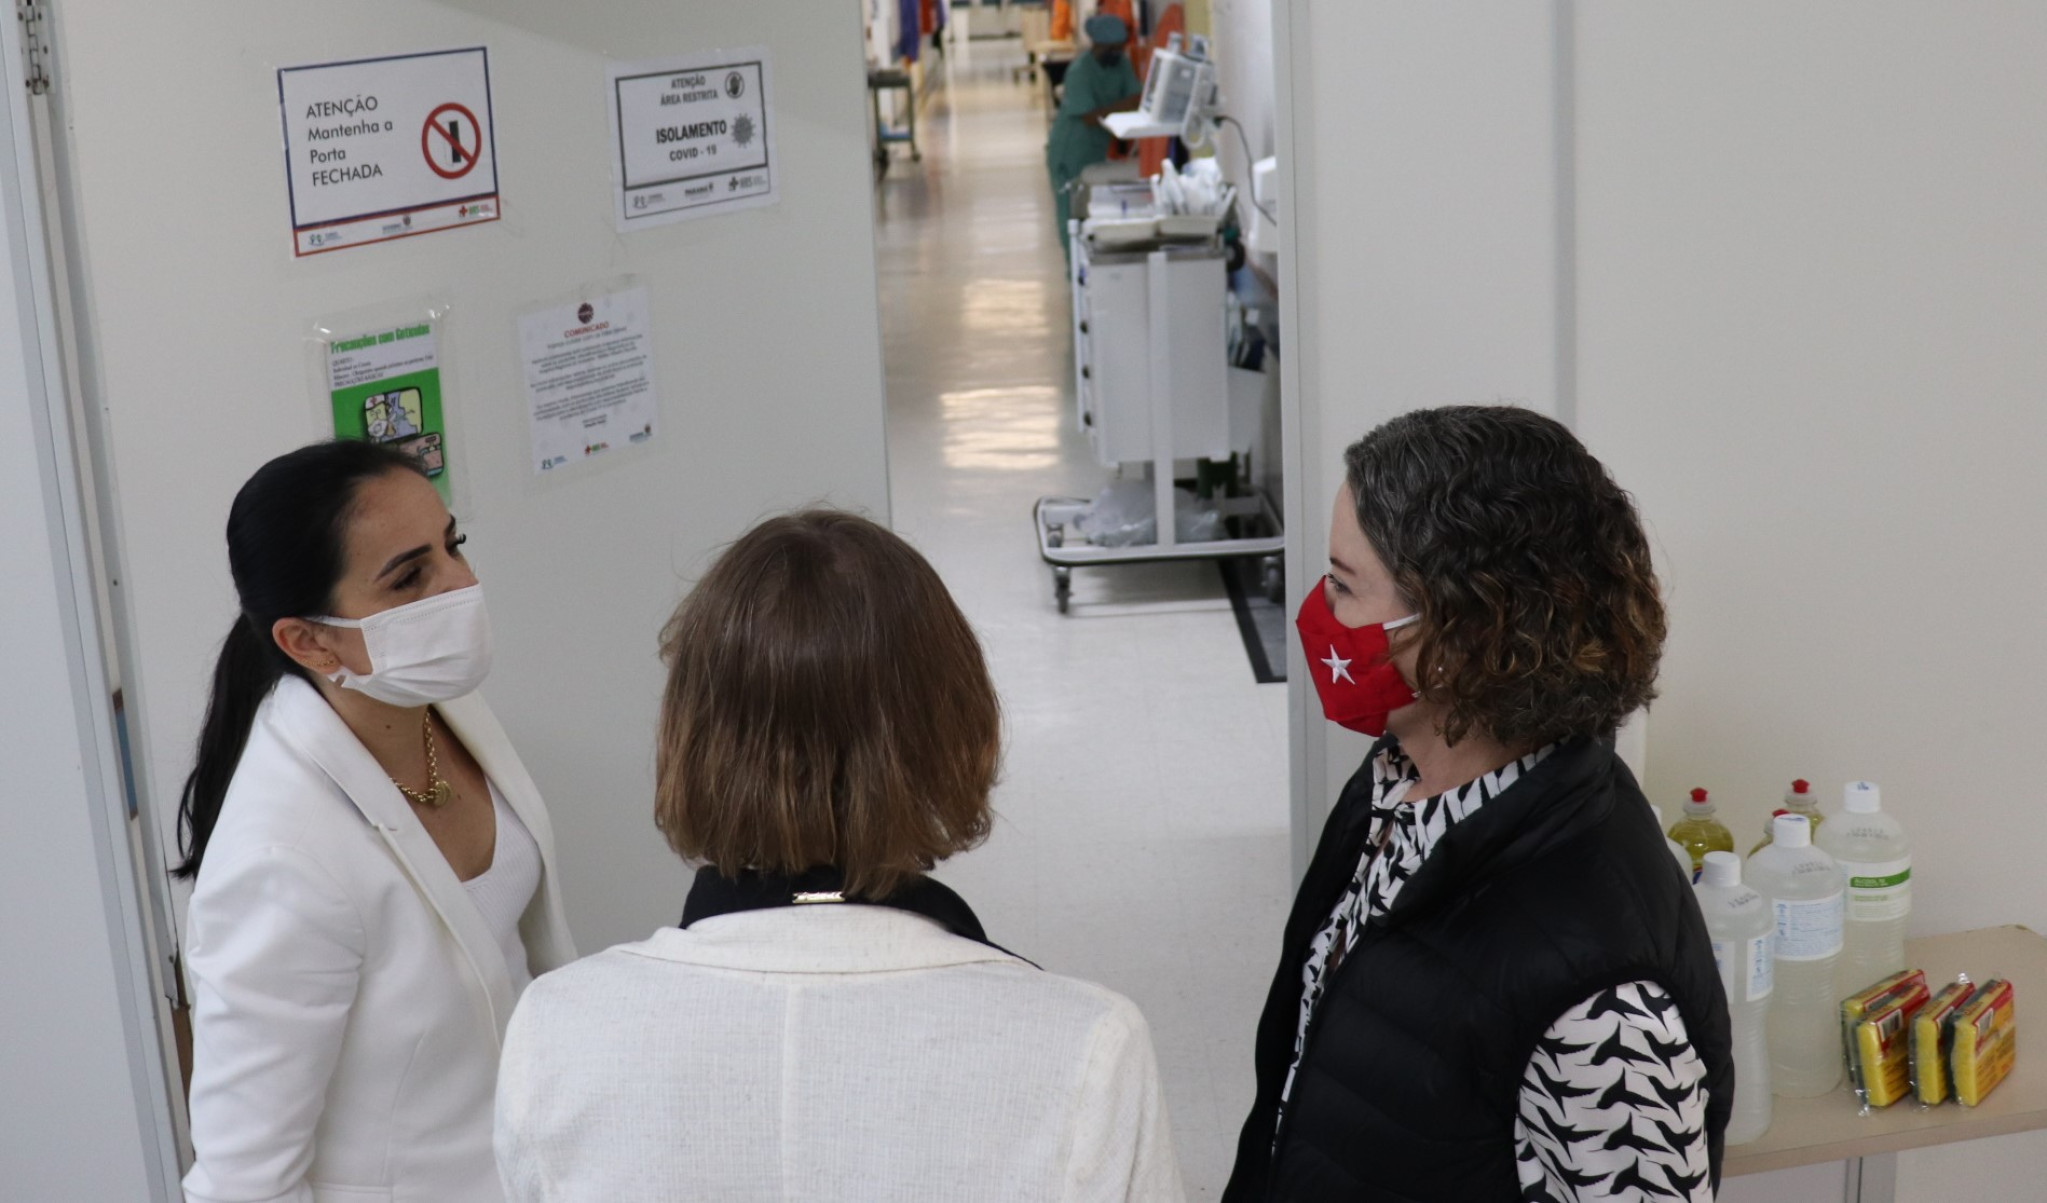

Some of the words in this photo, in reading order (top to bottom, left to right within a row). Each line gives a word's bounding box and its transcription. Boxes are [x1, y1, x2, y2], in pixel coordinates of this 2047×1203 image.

[671, 75, 705, 89] ATENÇÃO
[660, 92, 681, 106] ÁREA
[683, 90, 718, 103] RESTRITA
[306, 95, 378, 119] ATENÇÃO
[307, 120, 380, 142] Mantenha
[384, 121, 393, 132] a
[656, 120, 727, 144] ISOLAMENTO
[310, 148, 346, 164] Porta
[669, 148, 698, 162] COVID
[706, 145, 717, 156] 19
[312, 164, 383, 187] FECHADA
[564, 321, 609, 338] COMUNICADO
